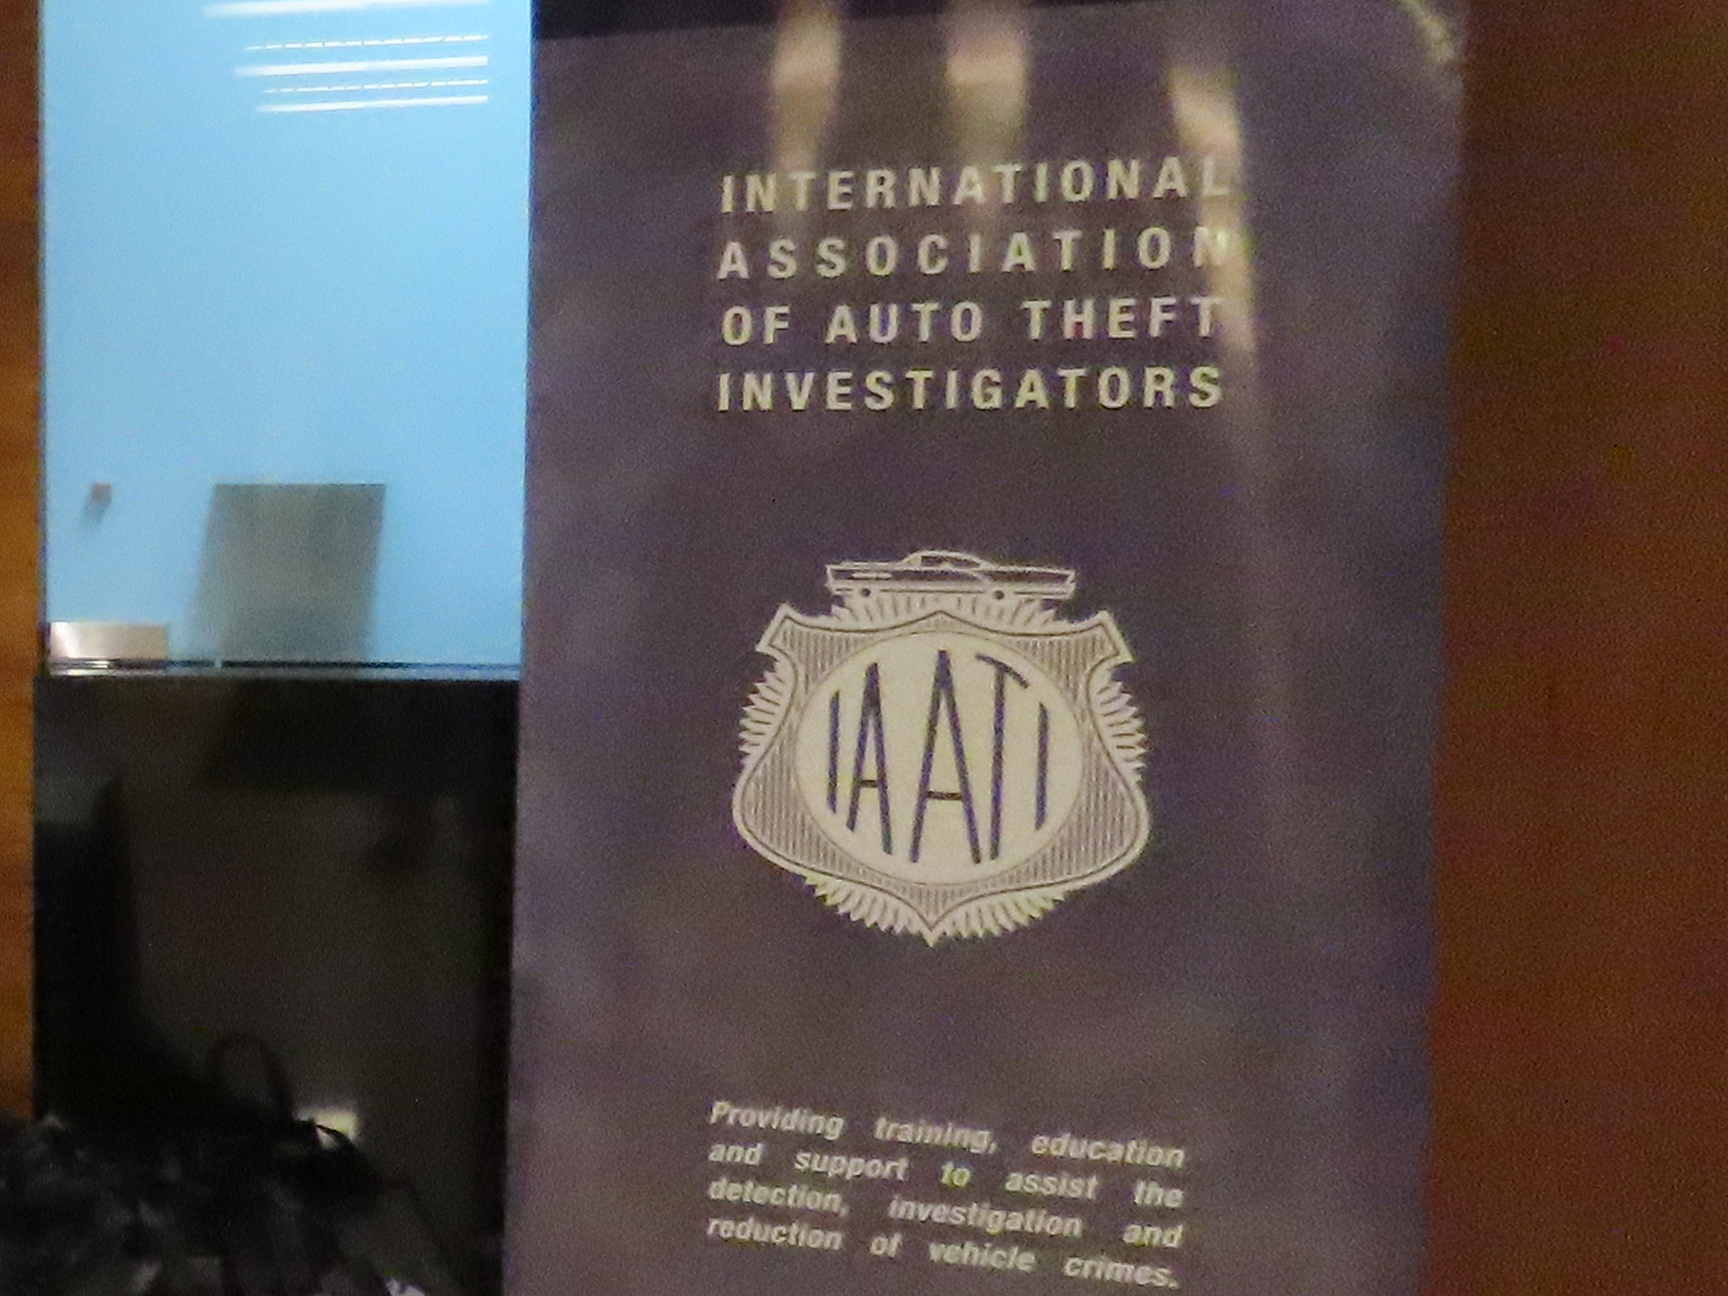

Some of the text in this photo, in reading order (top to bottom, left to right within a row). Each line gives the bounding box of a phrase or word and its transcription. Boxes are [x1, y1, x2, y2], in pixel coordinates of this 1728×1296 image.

[720, 157, 1234, 213] INTERNATIONAL
[716, 226, 1234, 280] ASSOCIATION
[721, 296, 1224, 346] OF AUTO THEFT
[716, 365, 1223, 413] INVESTIGATORS
[826, 649, 1049, 864] IAATI
[709, 1100, 1186, 1169] Providing training, education
[708, 1141, 1184, 1209] and support to assist the
[708, 1178, 1184, 1249] detection, investigation and
[707, 1215, 1181, 1291] reduction of vehicle crimes.
